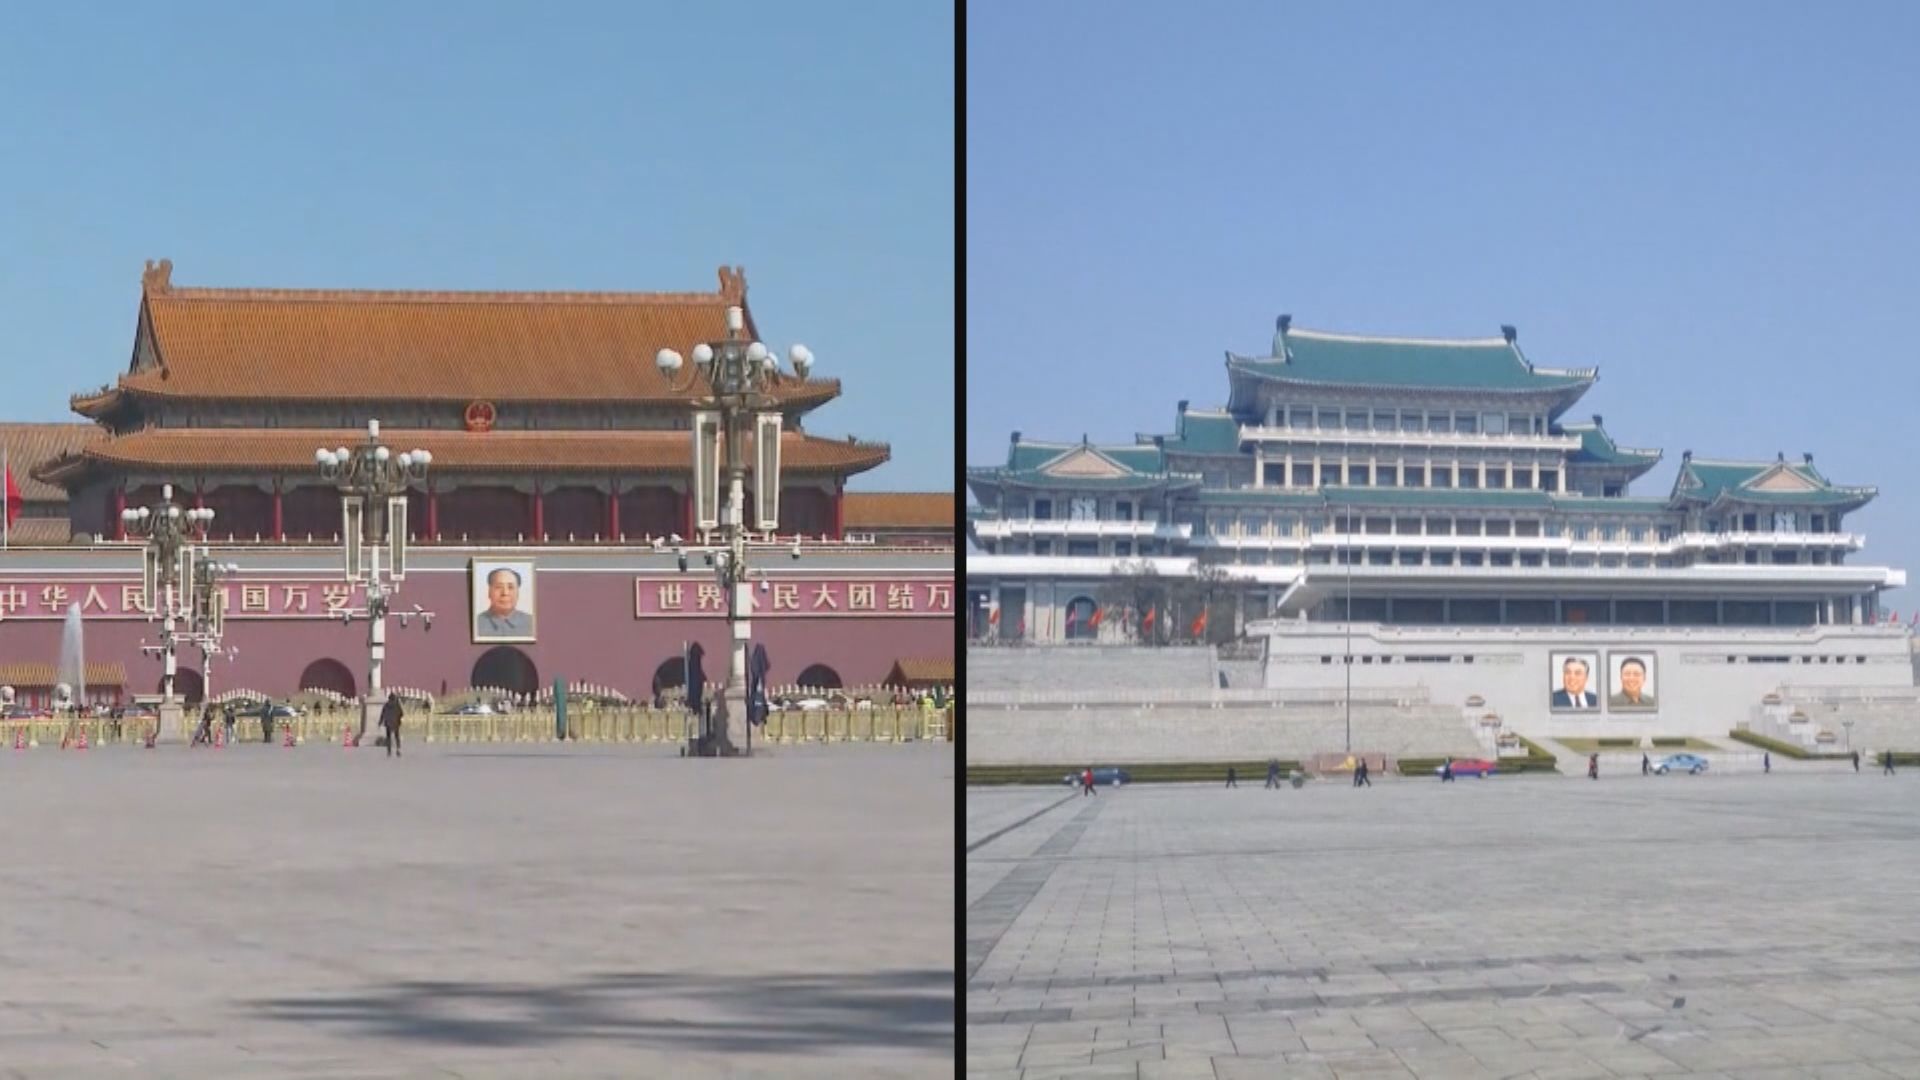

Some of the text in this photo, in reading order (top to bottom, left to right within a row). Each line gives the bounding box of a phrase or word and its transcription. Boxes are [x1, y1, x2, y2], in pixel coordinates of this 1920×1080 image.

[0, 585, 350, 612] 中华人民国万岁
